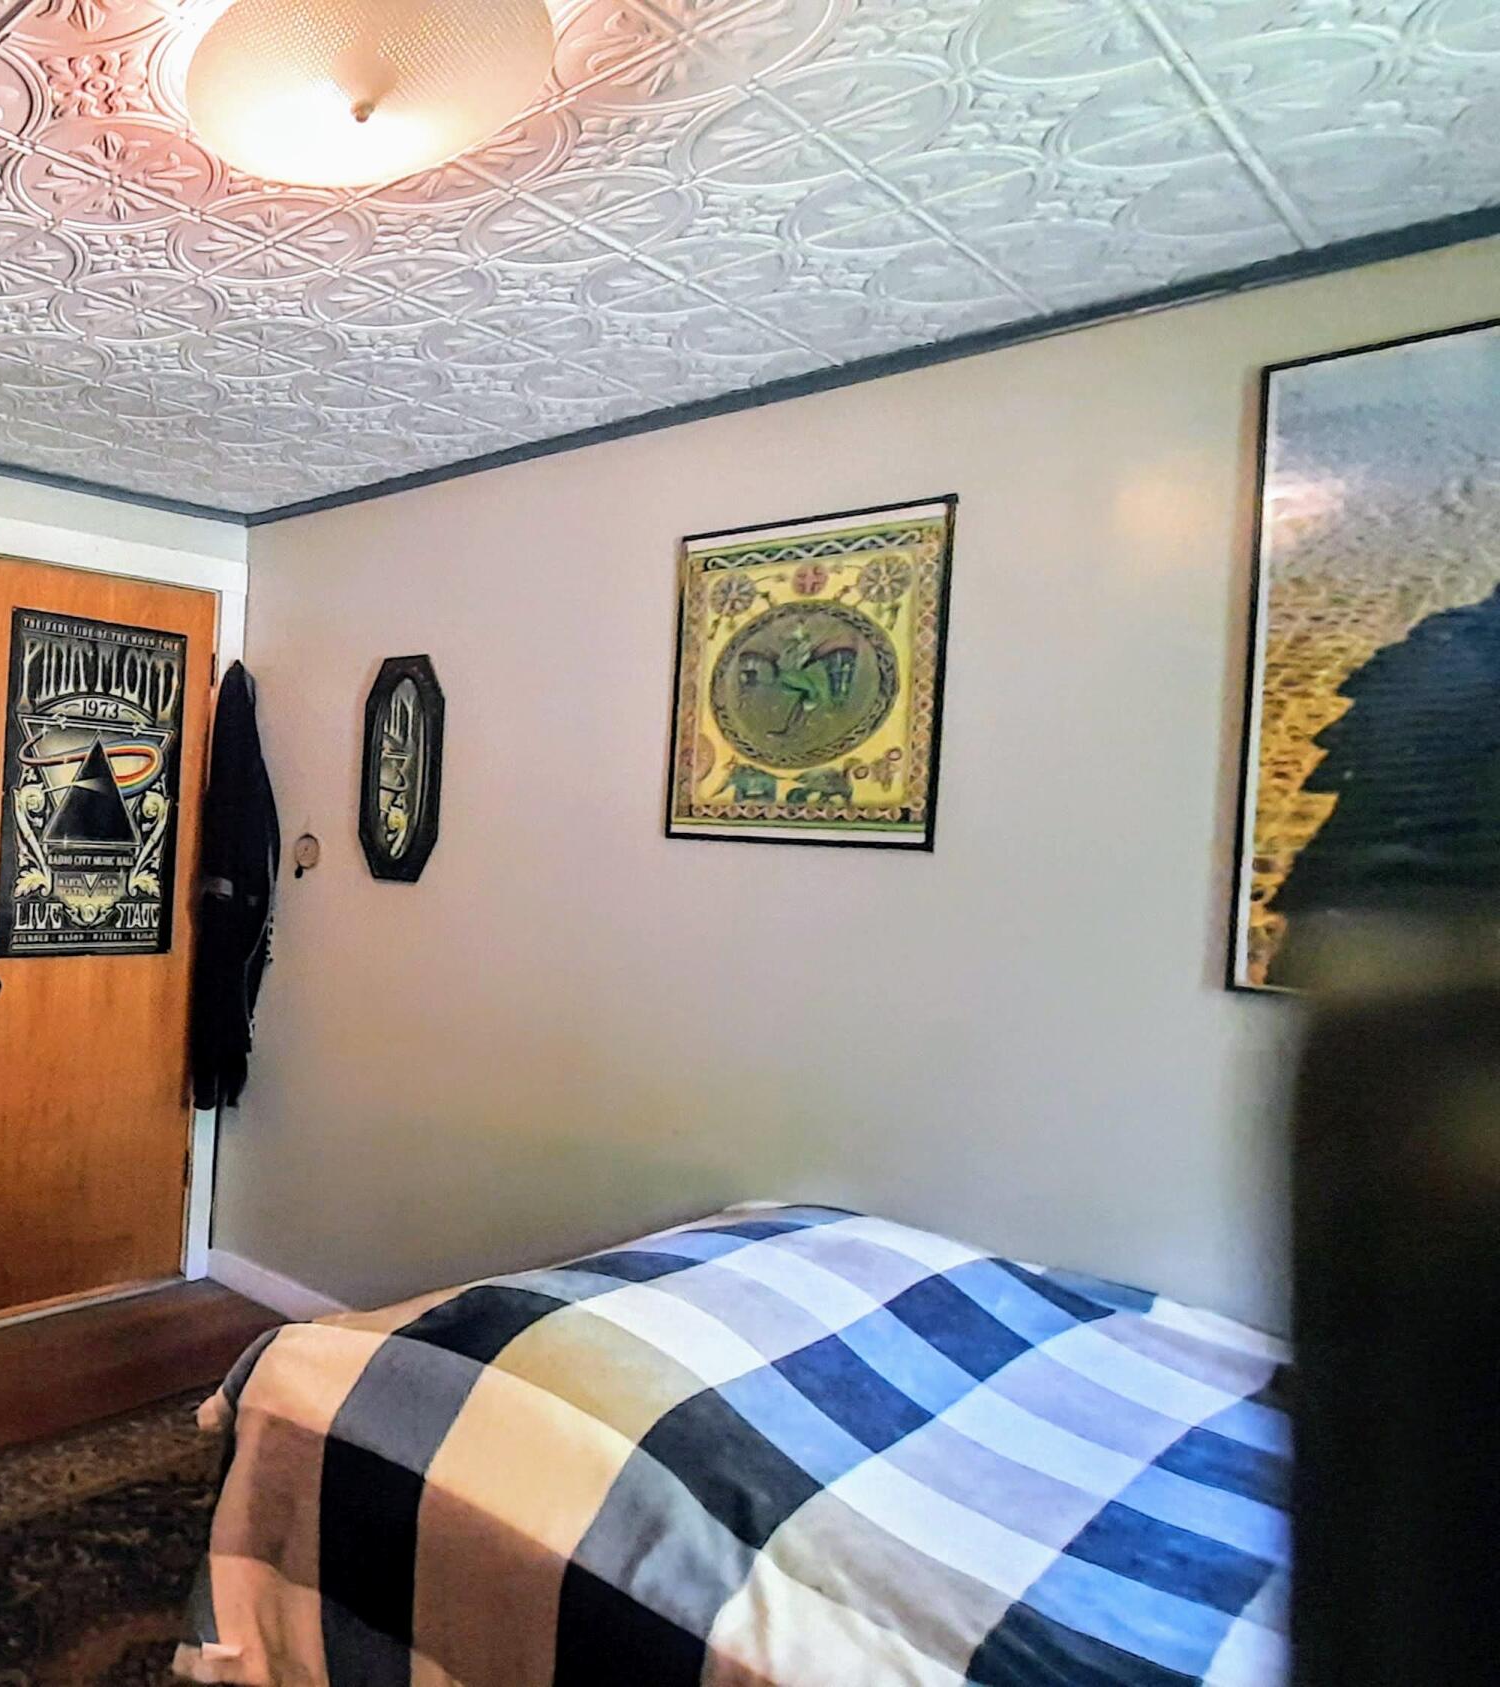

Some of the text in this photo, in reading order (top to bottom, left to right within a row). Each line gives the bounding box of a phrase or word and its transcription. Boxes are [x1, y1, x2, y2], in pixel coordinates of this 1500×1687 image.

[17, 635, 179, 724] PINK FLOYD
[82, 699, 119, 719] 1973
[48, 854, 73, 866] RADIO
[74, 855, 92, 866] CITY
[13, 902, 63, 930] LIVE
